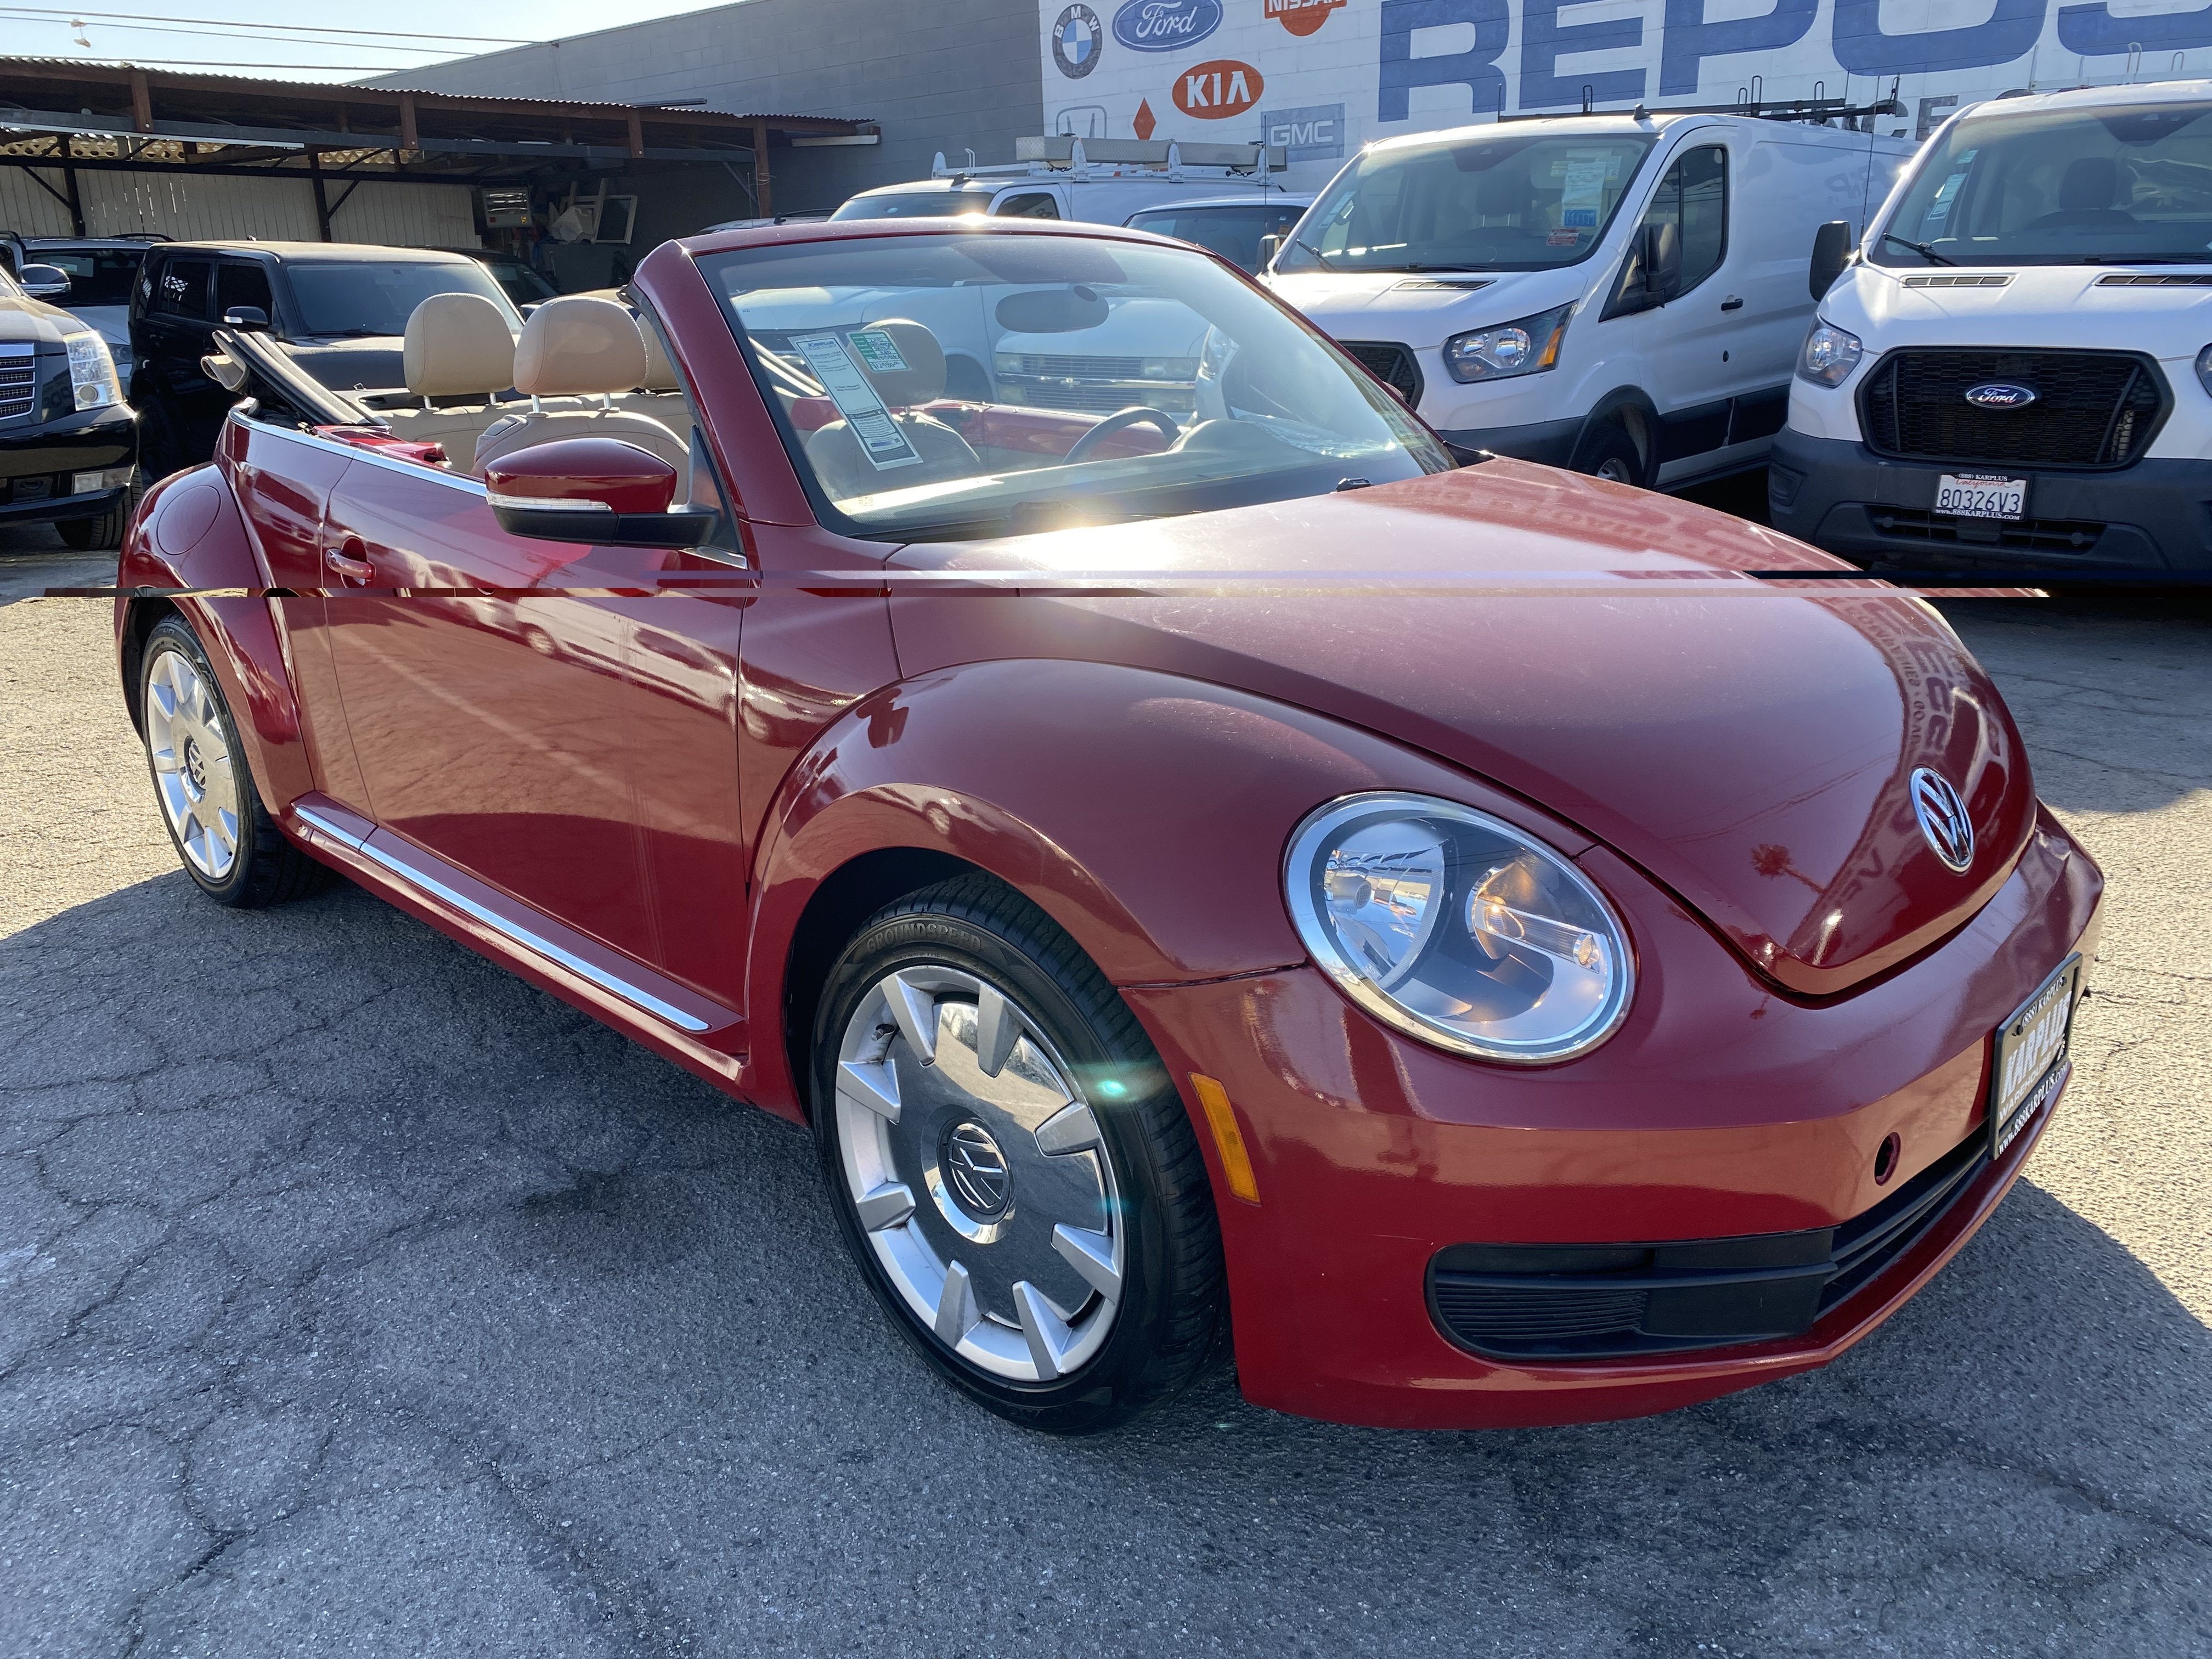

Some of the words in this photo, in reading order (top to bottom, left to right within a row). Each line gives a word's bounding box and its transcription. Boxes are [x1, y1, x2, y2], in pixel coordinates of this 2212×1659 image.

[1054, 5, 1100, 38] BMW
[1136, 1, 1198, 38] Ford
[1186, 70, 1251, 108] KIA
[1270, 120, 1334, 146] GMC
[1977, 388, 2018, 403] Ford
[1940, 488, 2021, 512] 80326V3
[866, 922, 982, 955] GROUNDSPEED
[2001, 990, 2072, 1104] KARPLUS
[1999, 1051, 2052, 1121] WAREHOUSE
